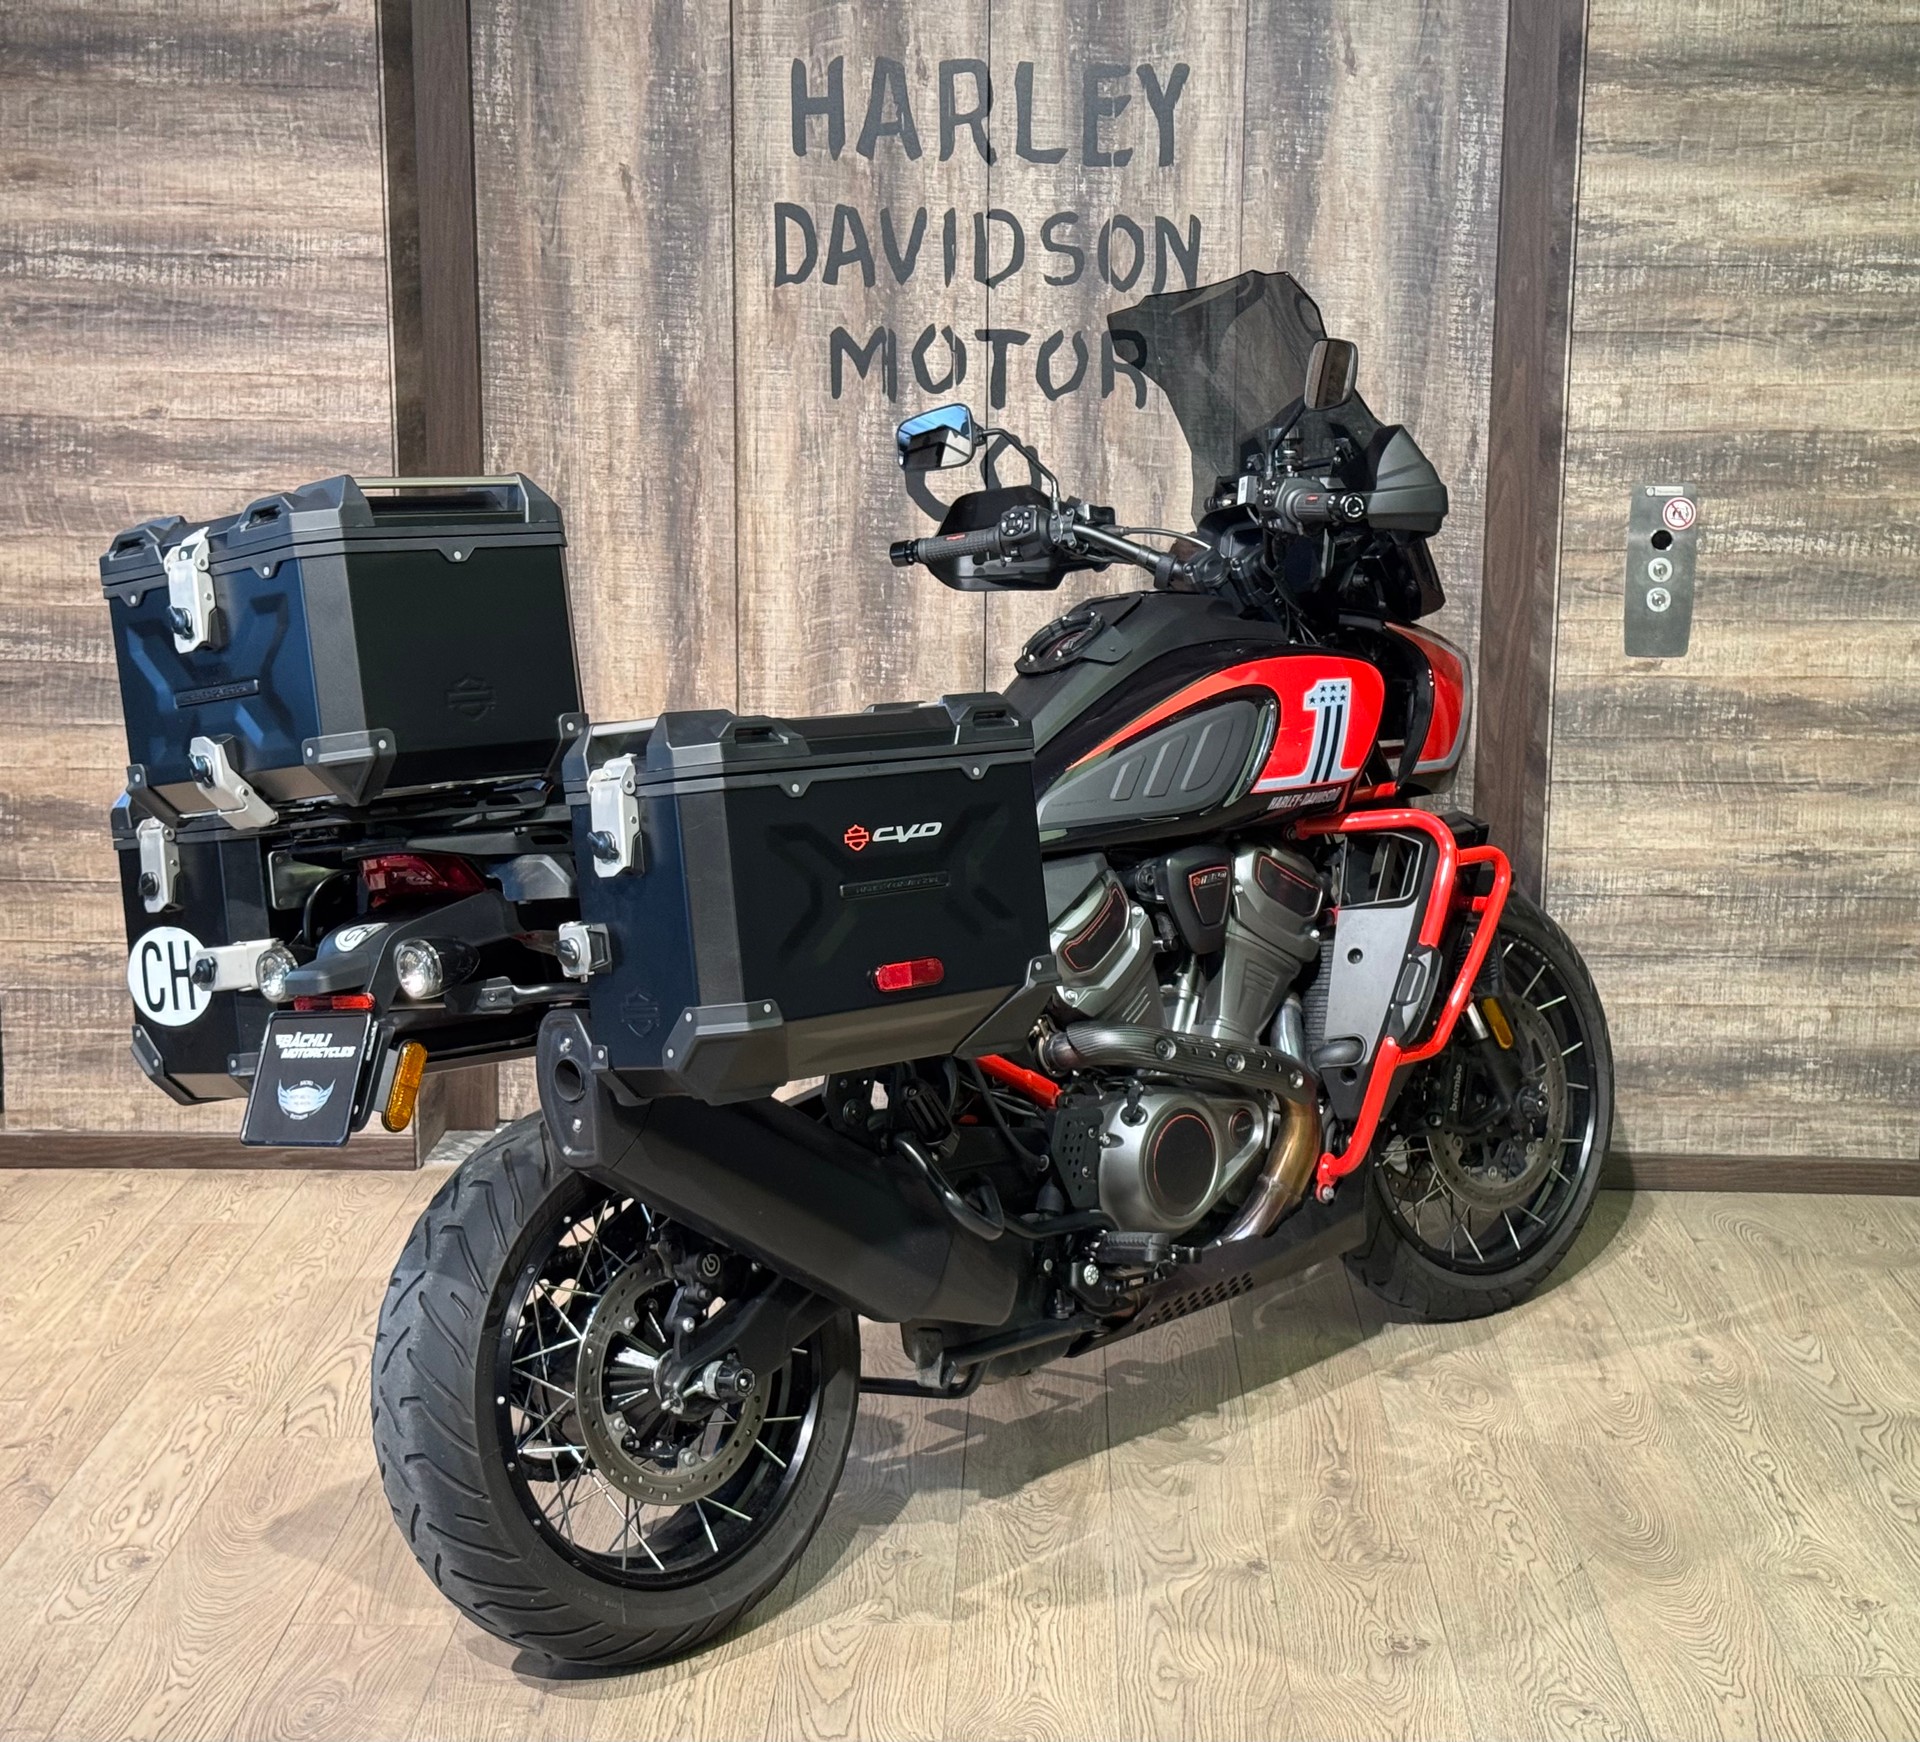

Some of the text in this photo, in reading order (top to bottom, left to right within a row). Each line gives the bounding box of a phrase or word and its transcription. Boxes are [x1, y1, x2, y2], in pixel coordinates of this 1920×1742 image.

[791, 55, 1190, 167] HARLEY
[774, 201, 1202, 293] DAVIDSON
[830, 323, 1148, 410] MOTOR
[872, 821, 943, 843] CVO
[1267, 786, 1343, 811] HARLEY-DAVIDSON
[141, 939, 197, 1013] CH
[1449, 1064, 1463, 1111] brembo
